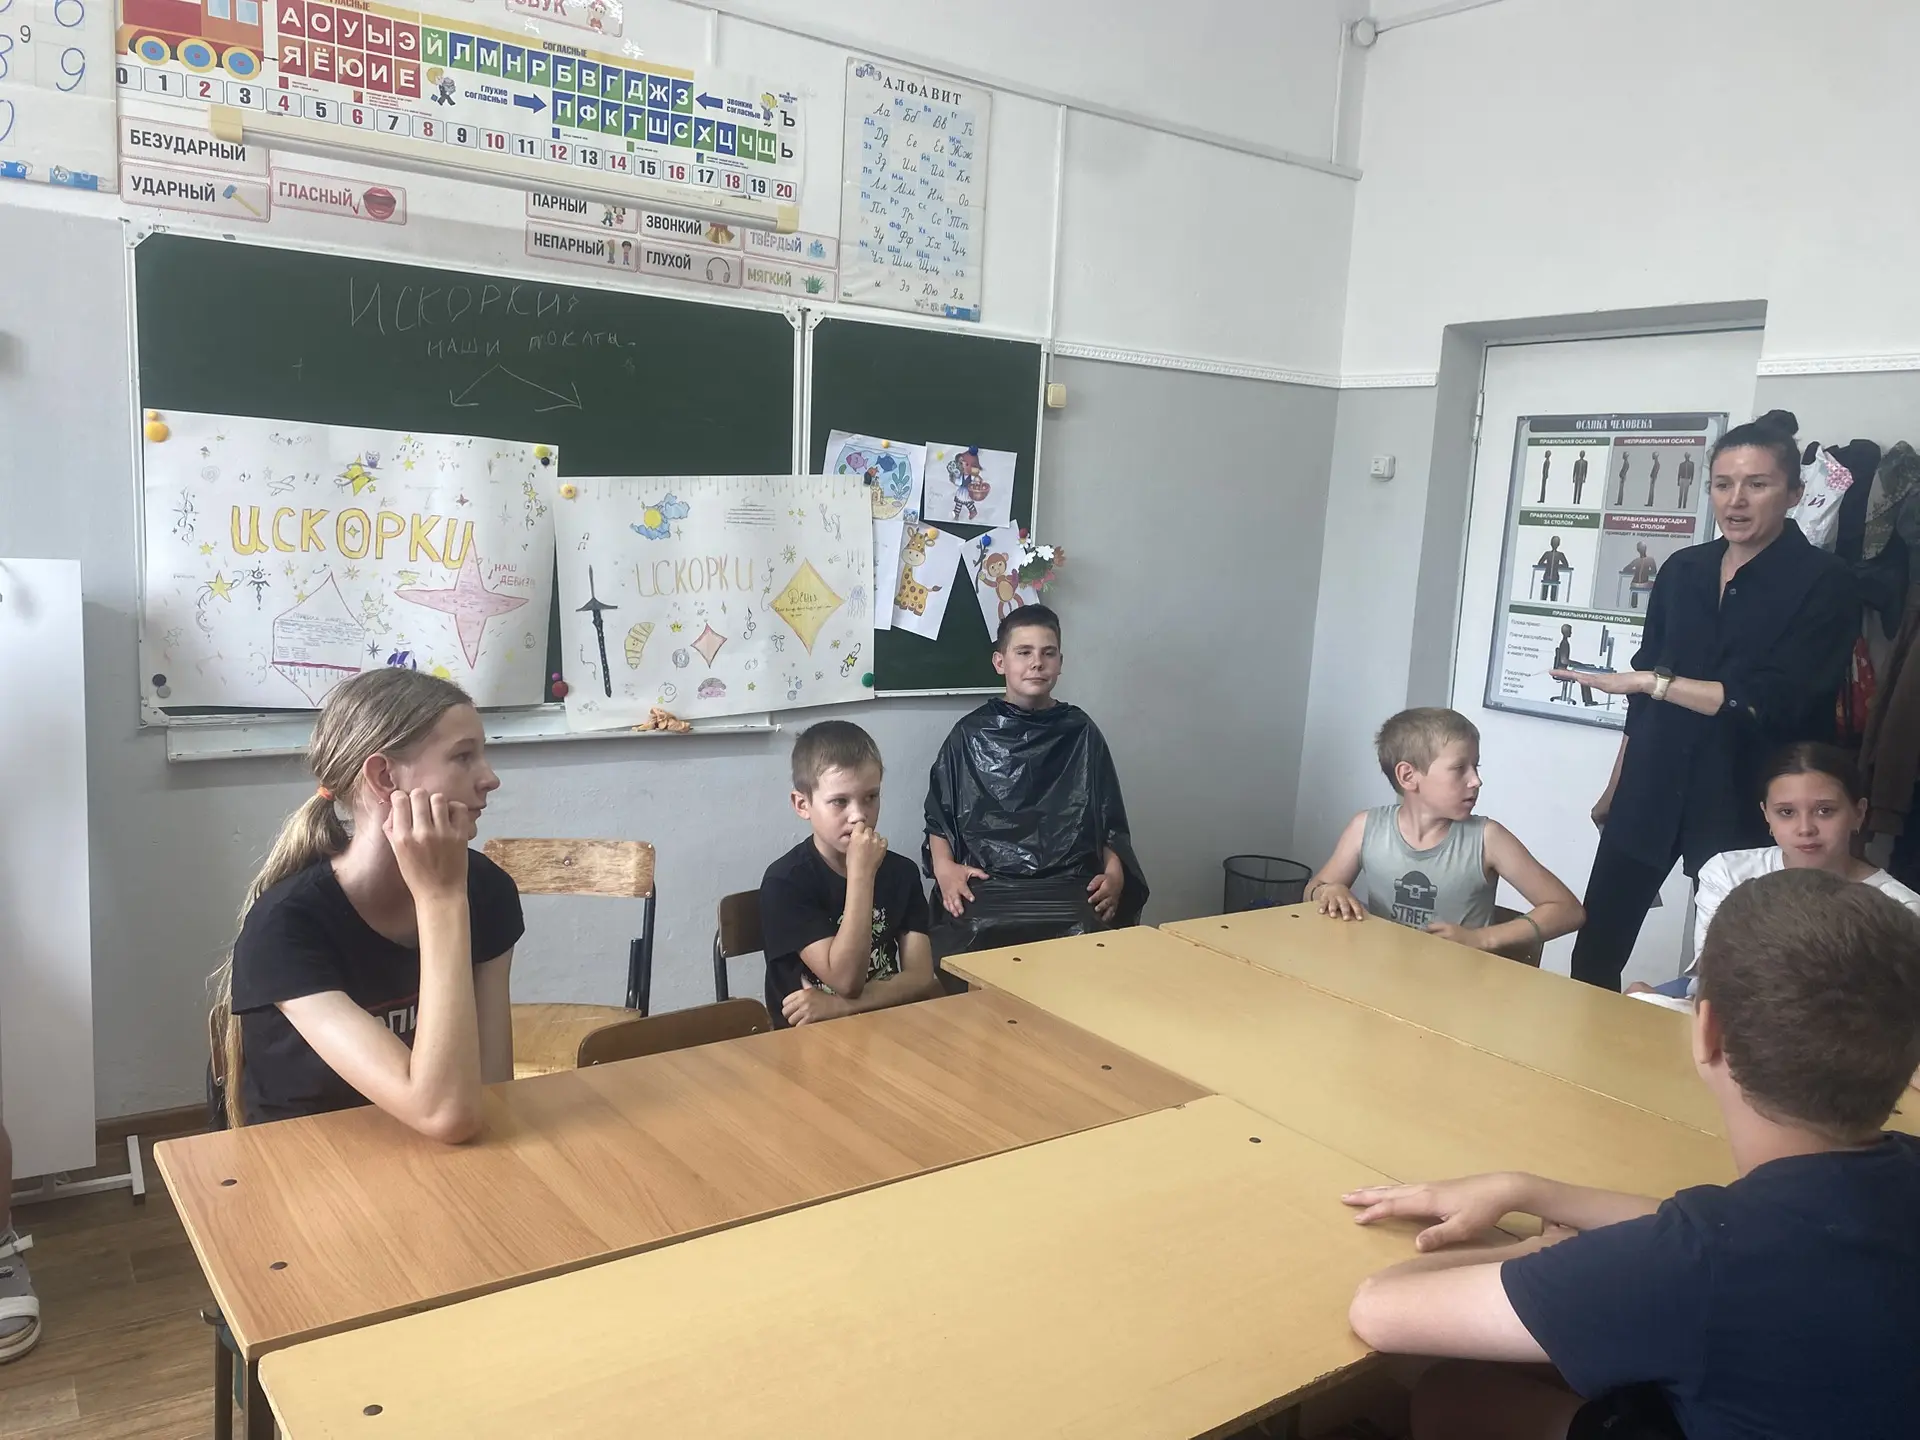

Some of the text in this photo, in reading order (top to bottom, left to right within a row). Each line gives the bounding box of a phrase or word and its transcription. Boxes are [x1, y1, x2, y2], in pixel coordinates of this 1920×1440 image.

[20, 24, 86, 92] 9 9
[281, 7, 689, 106] А О У Ы Э Й Л М Н Р Б В Г Д Ж З
[542, 41, 588, 58] СОГЛАСНЫЕ
[283, 45, 415, 89] Я Ё Ю И Е
[883, 76, 962, 106] АЛФАВИТ
[779, 109, 796, 127] Ъ
[873, 102, 891, 118] Аа
[903, 107, 922, 123] Бб
[932, 115, 948, 130] Вв
[116, 67, 792, 199] 0 1 2 3 4 5 6 7 8 9 10 11 12 13 14 15 16 17 18 19 20
[556, 99, 776, 160] П Ф К Т Ш С Х Ц Ч Щ
[781, 142, 794, 159] Ь
[949, 143, 974, 161] Жж
[902, 157, 918, 173] Ии
[956, 169, 971, 184] Кк
[131, 175, 216, 203] УДАРНЫЙ
[278, 182, 354, 208] ГЛАСНЫЙ
[893, 182, 916, 197] Мм
[927, 187, 944, 202] Нн
[958, 193, 969, 207] Оо
[645, 214, 703, 236] ЗВОНКИЙ
[869, 201, 970, 231] Пп Рр Сс Тт
[533, 231, 605, 257] НЕПАРНЫЙ
[749, 231, 803, 253] ТВЁРДЫЙ
[873, 226, 966, 257] Уу Фф Хх Цц
[645, 251, 692, 271] ГЛУХОЙ
[870, 250, 884, 264] Чч
[892, 254, 913, 269] Шш
[918, 258, 940, 275] Щщ
[747, 270, 792, 288] МЯГКИЙ
[899, 279, 911, 292] Ээ
[922, 283, 939, 297] Юю
[949, 287, 965, 301] Яя
[349, 277, 562, 335] ИСКОРКИ
[427, 339, 501, 360] НАШИ
[1575, 418, 1653, 430] ОСАНКА ЧЕЛОВЕКА
[1670, 437, 1696, 445] ОСАНКА
[1529, 512, 1590, 521] ПРАВИЛЬНАЯ ПОСАДКА
[1612, 515, 1657, 524] НЕПРАВИЛЬНАЯ
[230, 503, 475, 570] ИСКОРКИ
[494, 563, 518, 573] НАШ
[634, 554, 754, 597] ИСКОРКИ
[1552, 610, 1587, 619] ПРАВИЛЬНАЯ
[1614, 615, 1631, 623] ПОЗА
